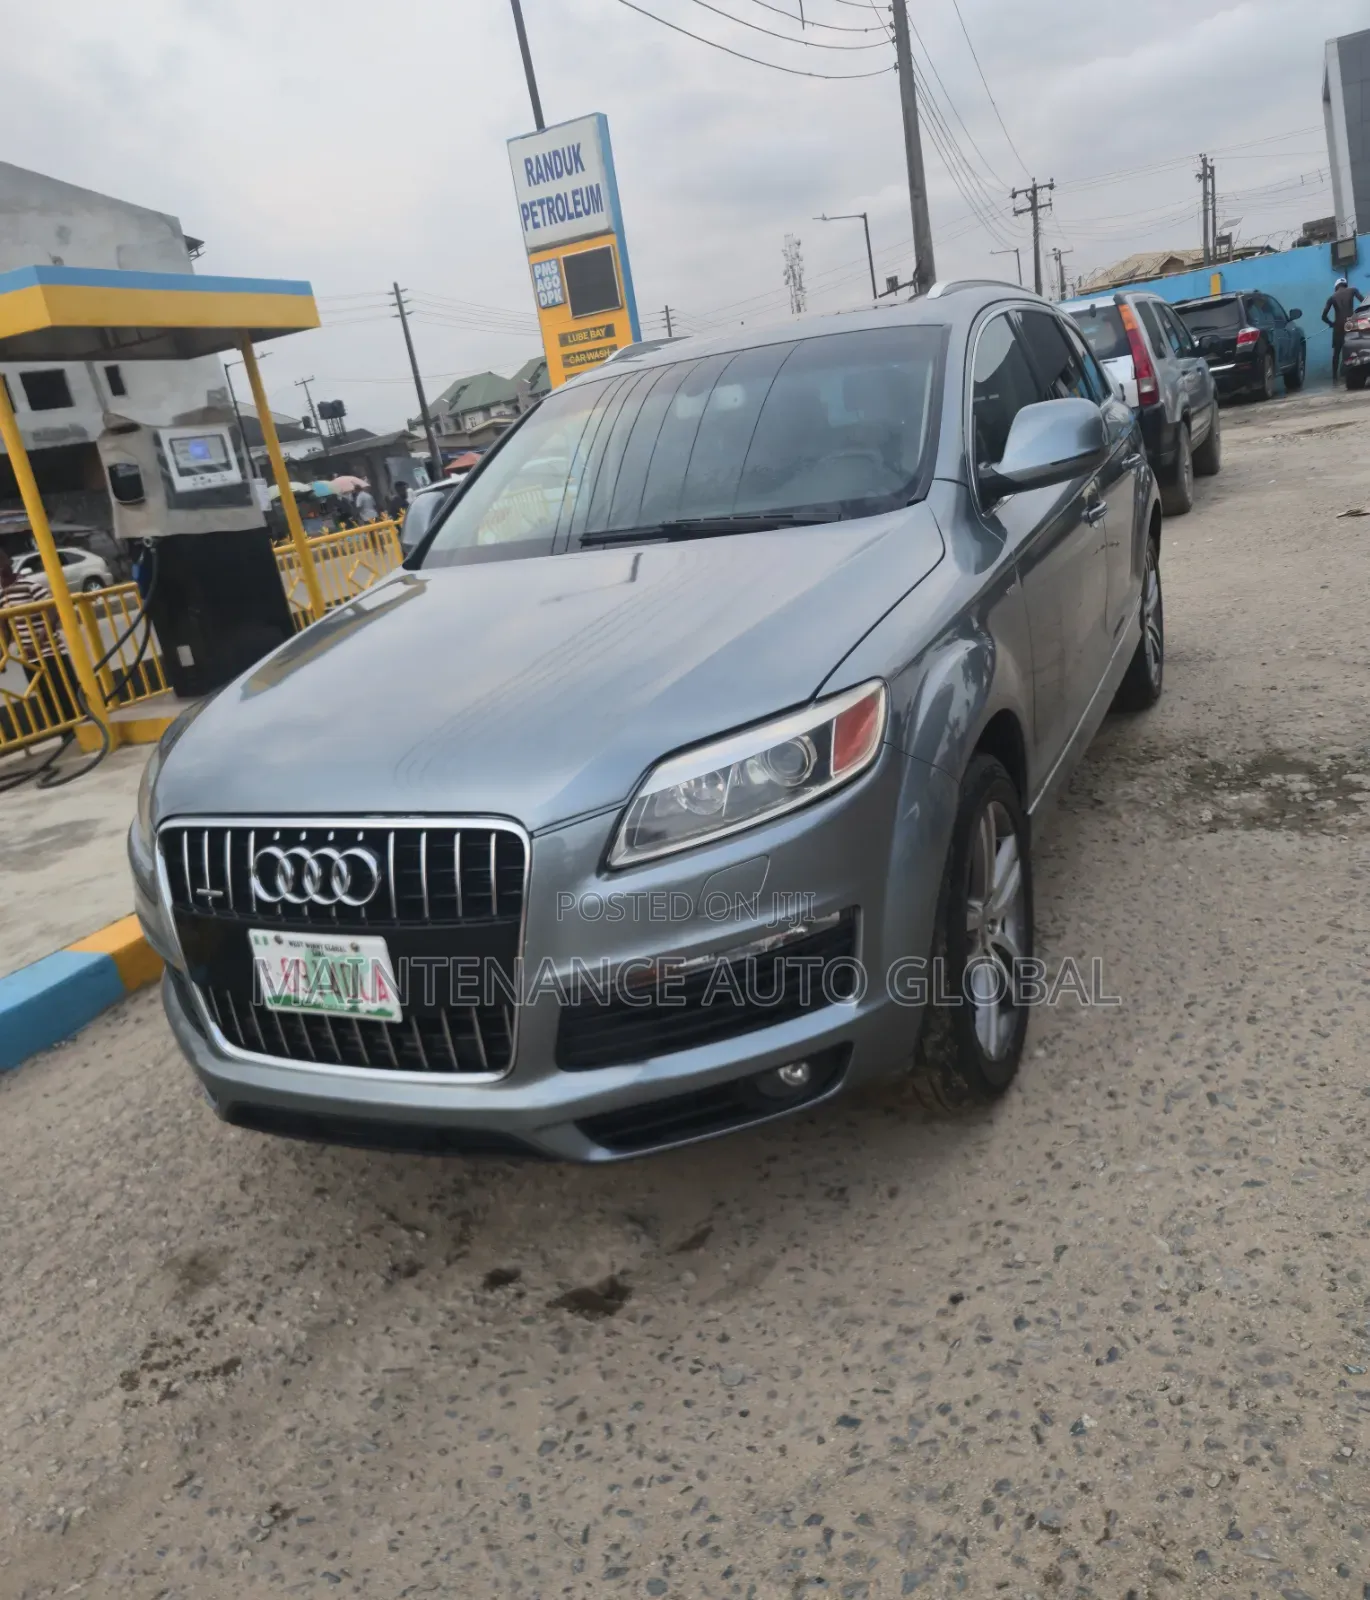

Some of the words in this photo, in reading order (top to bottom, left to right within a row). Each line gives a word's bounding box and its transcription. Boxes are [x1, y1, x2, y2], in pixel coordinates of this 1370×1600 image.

[524, 143, 585, 187] RANDUK
[520, 183, 604, 232] PETROLEUM
[533, 259, 558, 278] PMS
[537, 275, 561, 292] AGO
[539, 289, 564, 306] DPK
[567, 332, 589, 343] LUBE
[590, 327, 607, 339] BAY
[587, 347, 612, 361] WASH
